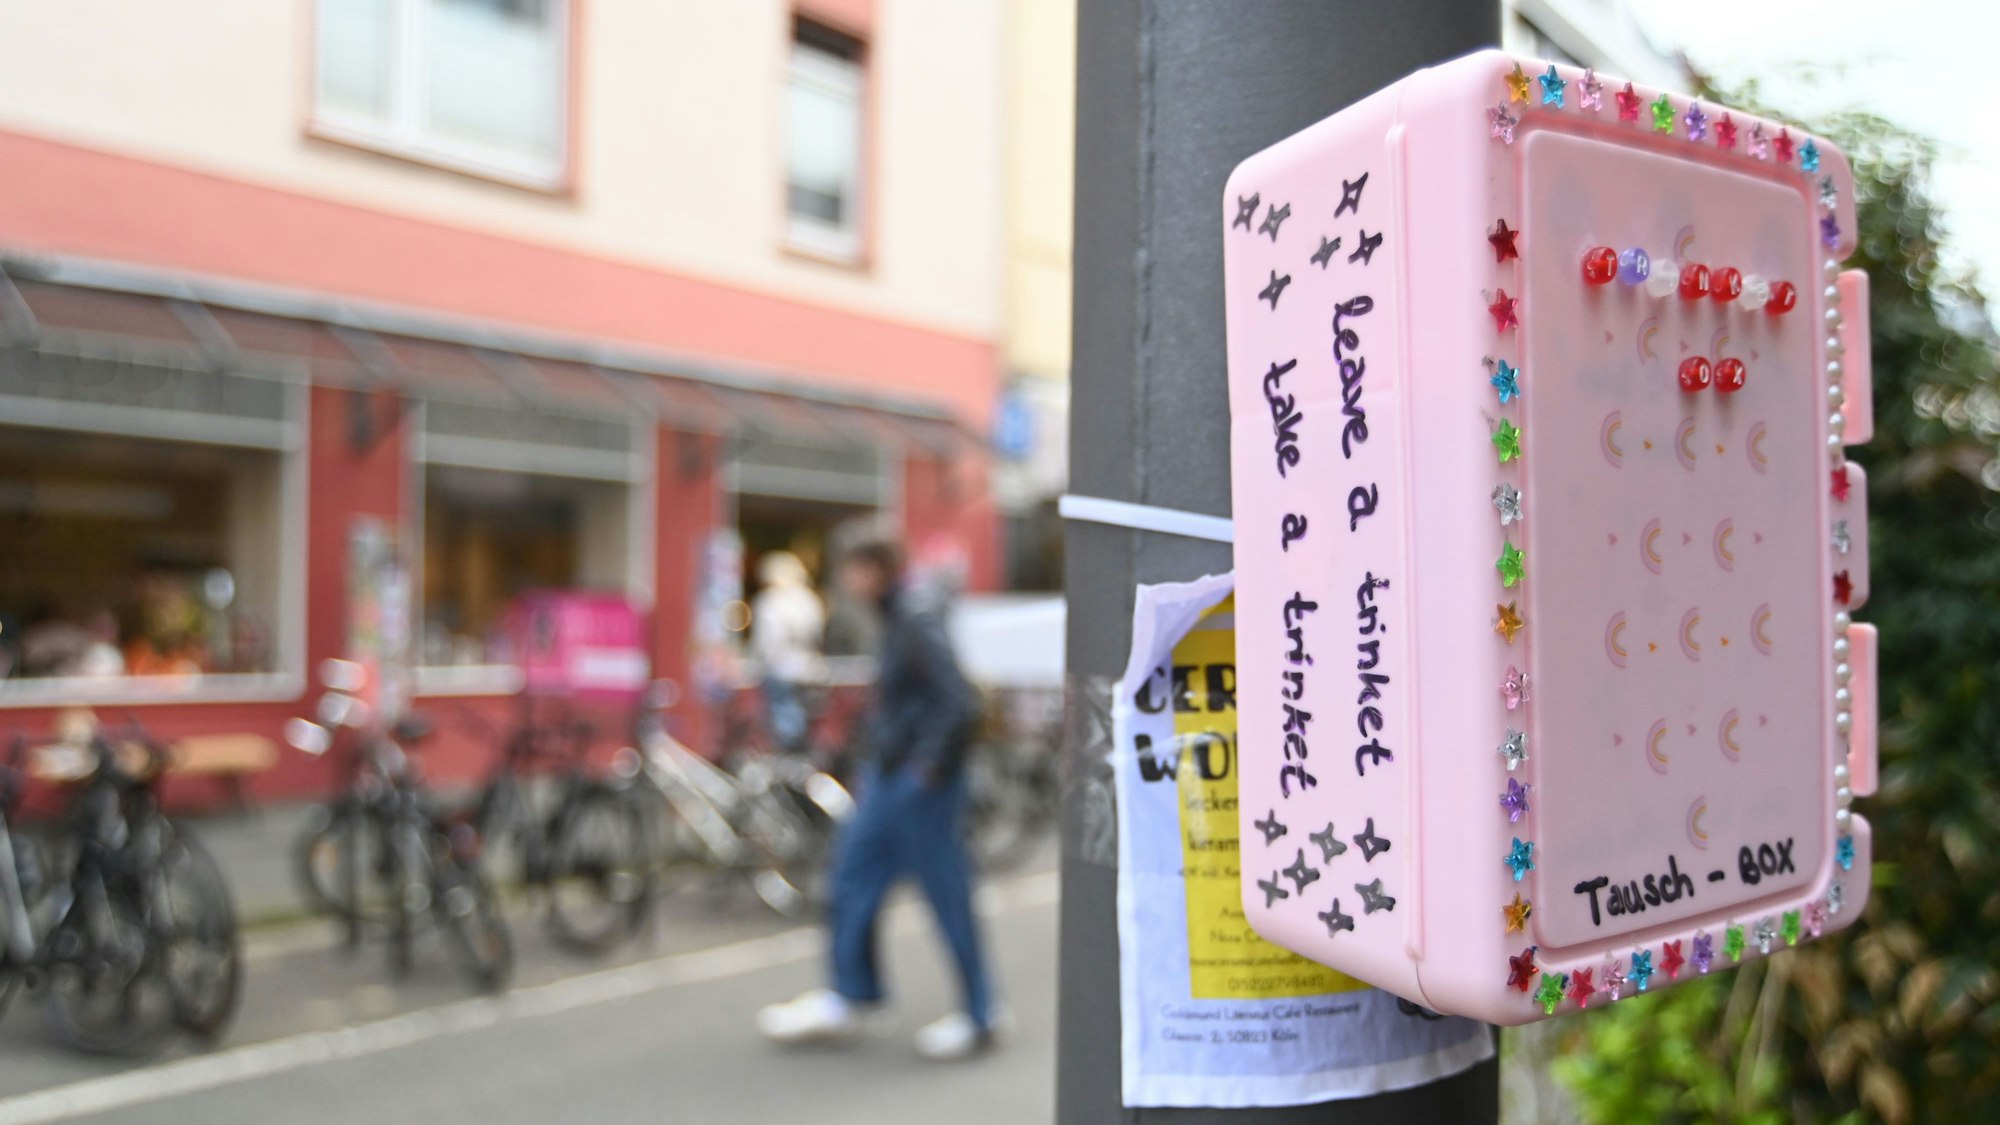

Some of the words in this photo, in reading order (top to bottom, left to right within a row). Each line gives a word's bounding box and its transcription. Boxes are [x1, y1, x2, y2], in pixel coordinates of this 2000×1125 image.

[1263, 358, 1304, 479] take
[1332, 295, 1374, 459] leave
[1281, 513, 1308, 553] a
[1347, 482, 1378, 532] a
[1280, 591, 1319, 799] trinket
[1355, 571, 1393, 777] trinket
[1573, 855, 1694, 926] Tausch
